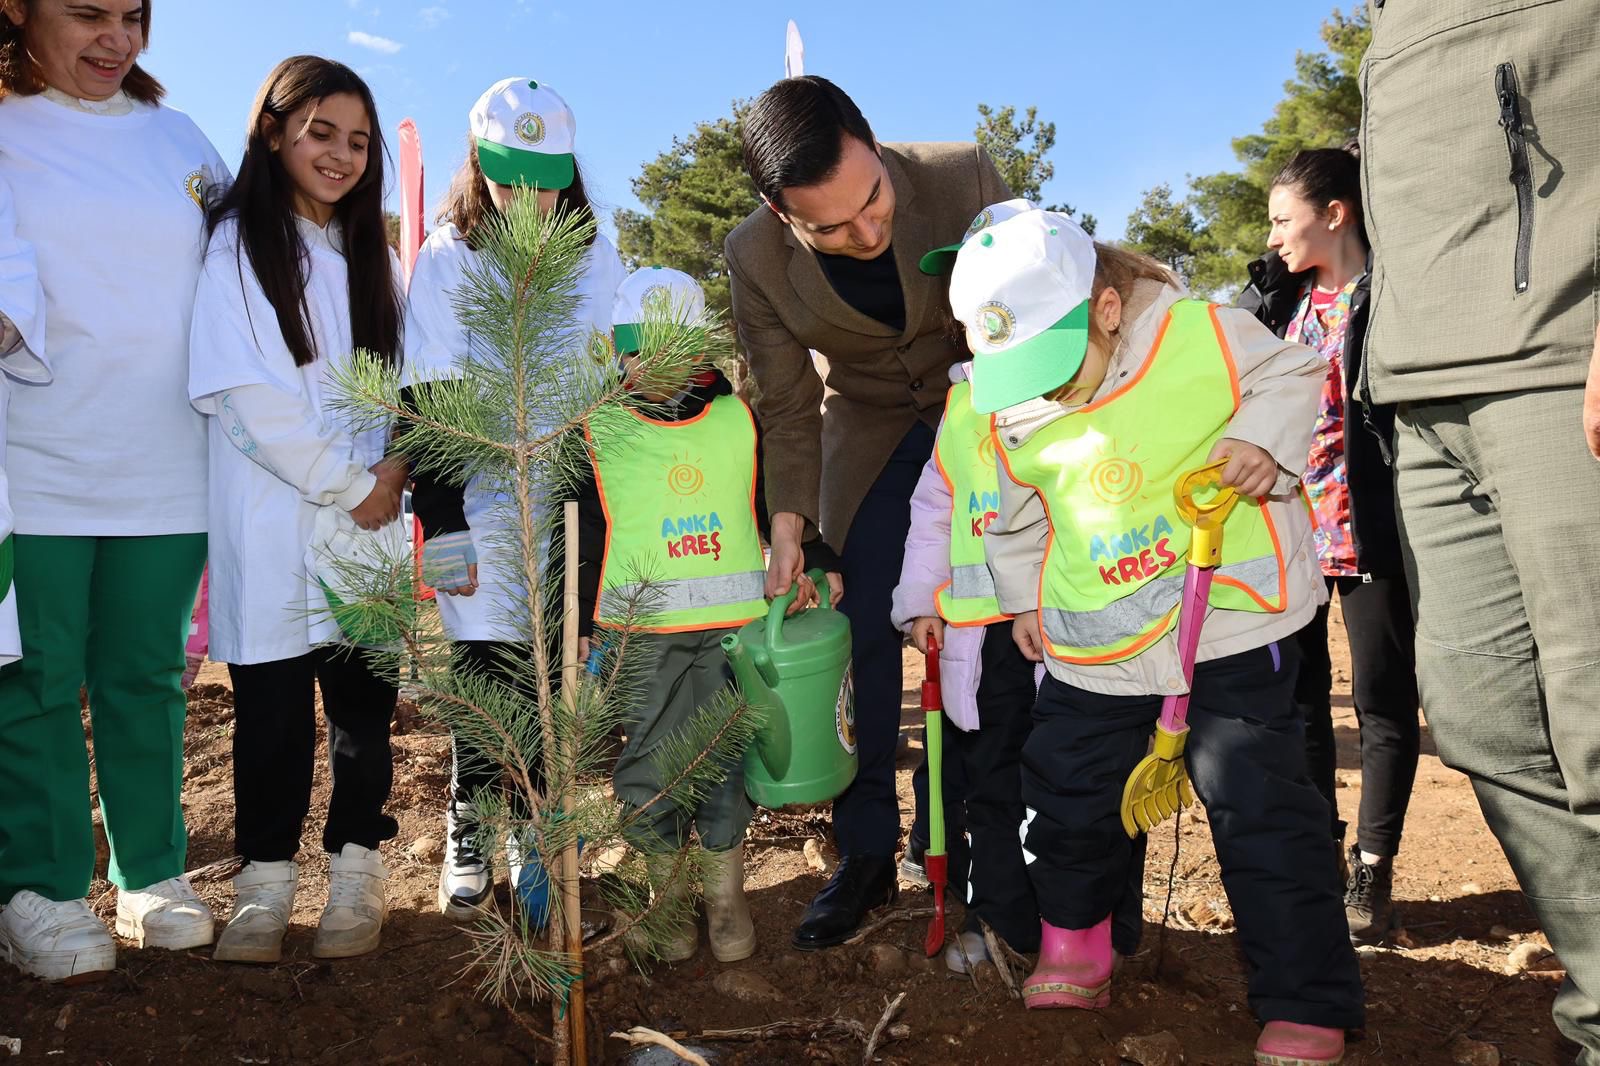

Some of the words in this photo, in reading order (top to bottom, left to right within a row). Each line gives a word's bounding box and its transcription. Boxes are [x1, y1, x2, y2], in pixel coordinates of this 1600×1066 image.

[969, 491, 998, 513] AN
[662, 511, 723, 537] ANKA
[668, 532, 721, 561] KREŞ
[1090, 515, 1173, 561] ANKA
